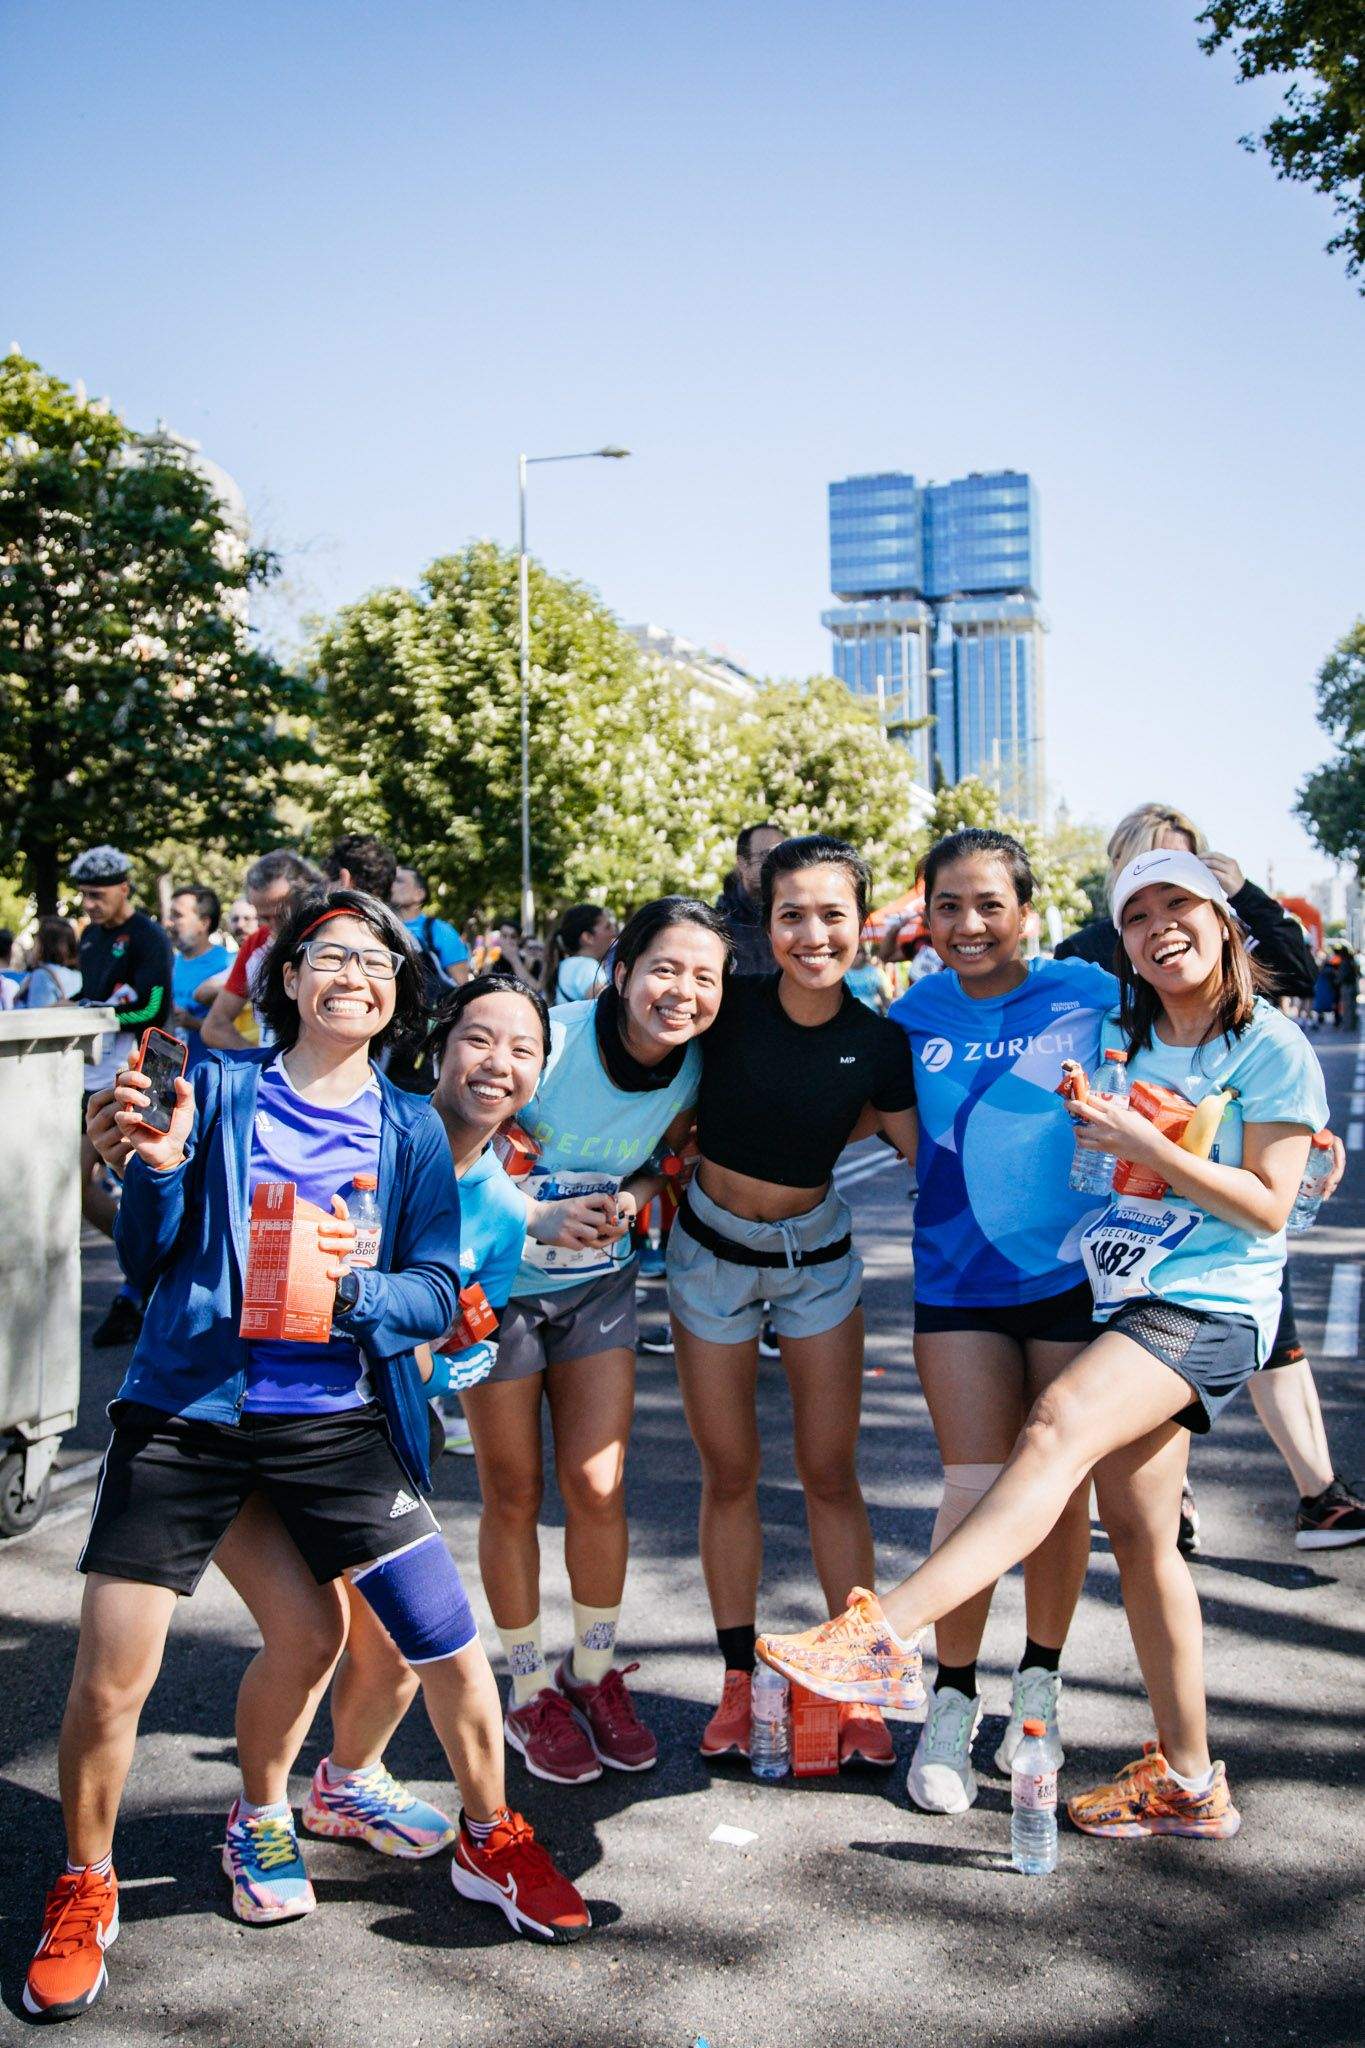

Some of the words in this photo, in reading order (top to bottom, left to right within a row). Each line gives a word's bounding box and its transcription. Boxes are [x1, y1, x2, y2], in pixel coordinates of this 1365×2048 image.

[963, 1033, 1074, 1062] ZURICH
[840, 1056, 856, 1064] MP
[1115, 1210, 1170, 1228] BOMBEROS
[1101, 1227, 1156, 1245] DECIMAS
[389, 1500, 420, 1519] adidas
